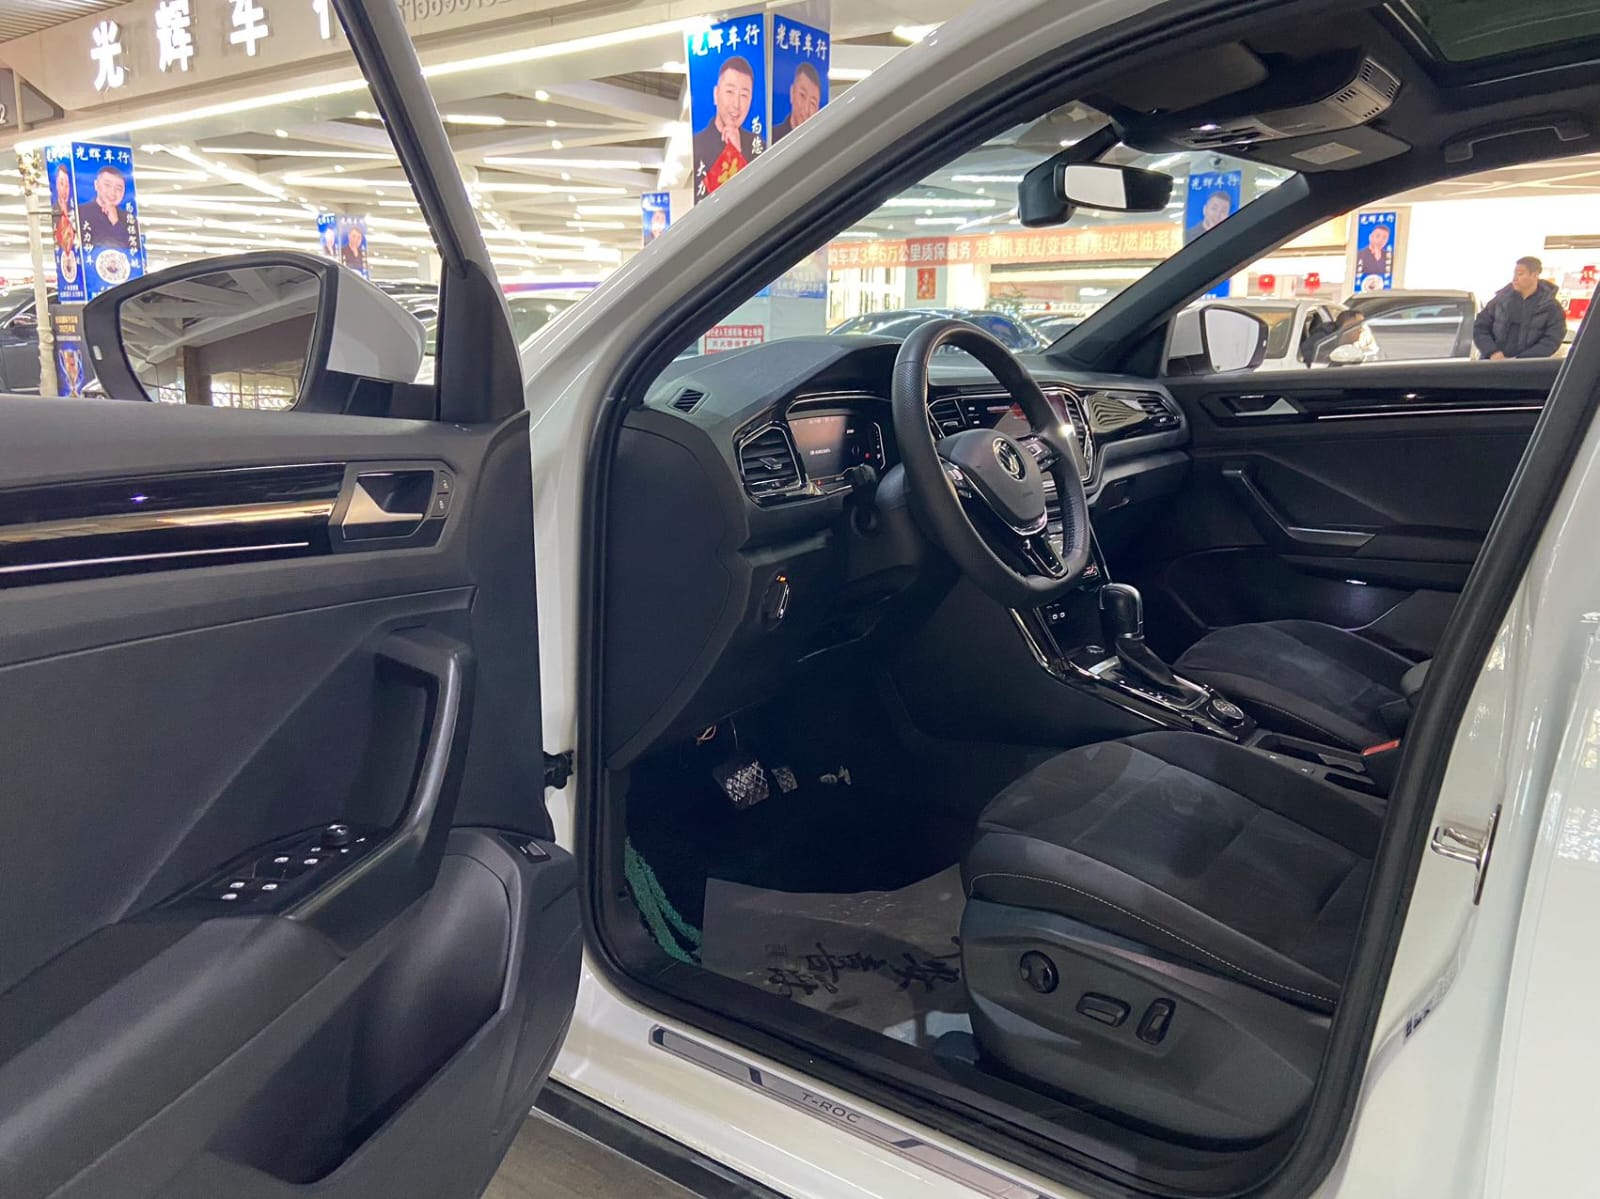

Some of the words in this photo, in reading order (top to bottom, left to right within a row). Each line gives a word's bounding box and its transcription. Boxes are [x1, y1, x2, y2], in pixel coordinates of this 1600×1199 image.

[751, 116, 764, 154] 为您
[696, 160, 709, 196] 大力
[802, 1092, 860, 1123] T-ROC
